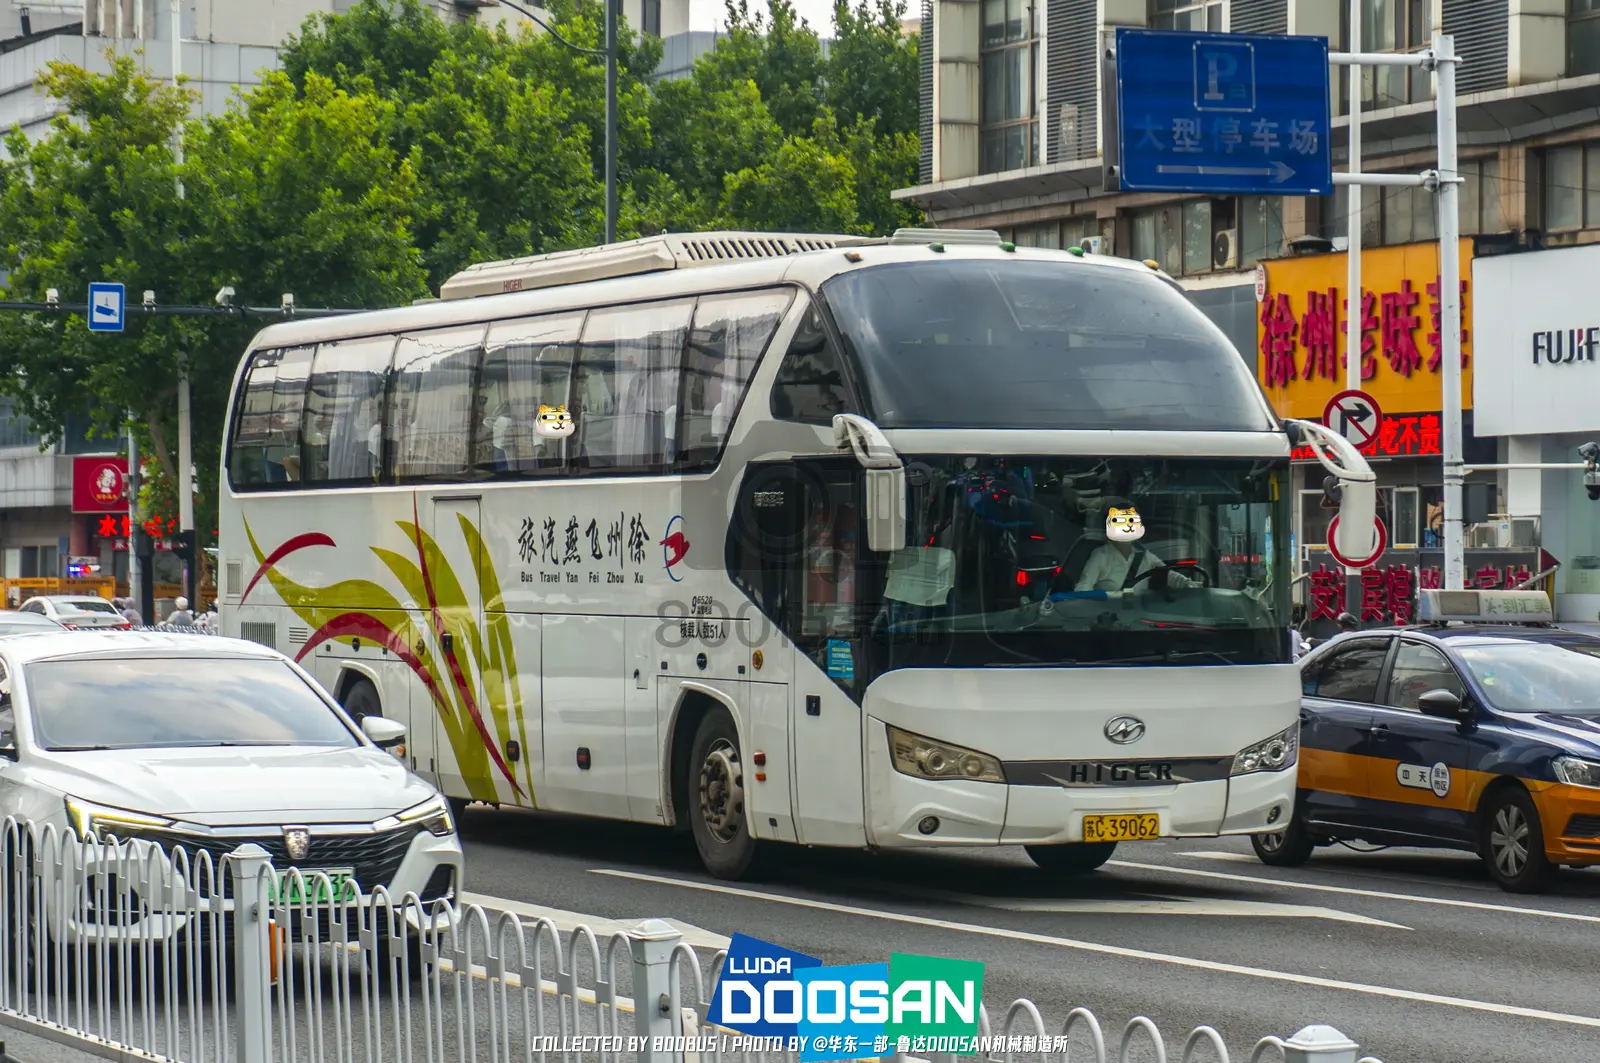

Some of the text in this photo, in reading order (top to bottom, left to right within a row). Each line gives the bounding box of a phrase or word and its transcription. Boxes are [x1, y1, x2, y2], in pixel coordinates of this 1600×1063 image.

[1134, 114, 1318, 155] 大型停车场
[503, 278, 523, 293] HIGER
[521, 571, 644, 583] Bus Travel Yan Fei Zhou Xu
[680, 620, 726, 640] 核载人数51人
[1069, 763, 1173, 783] HIGER
